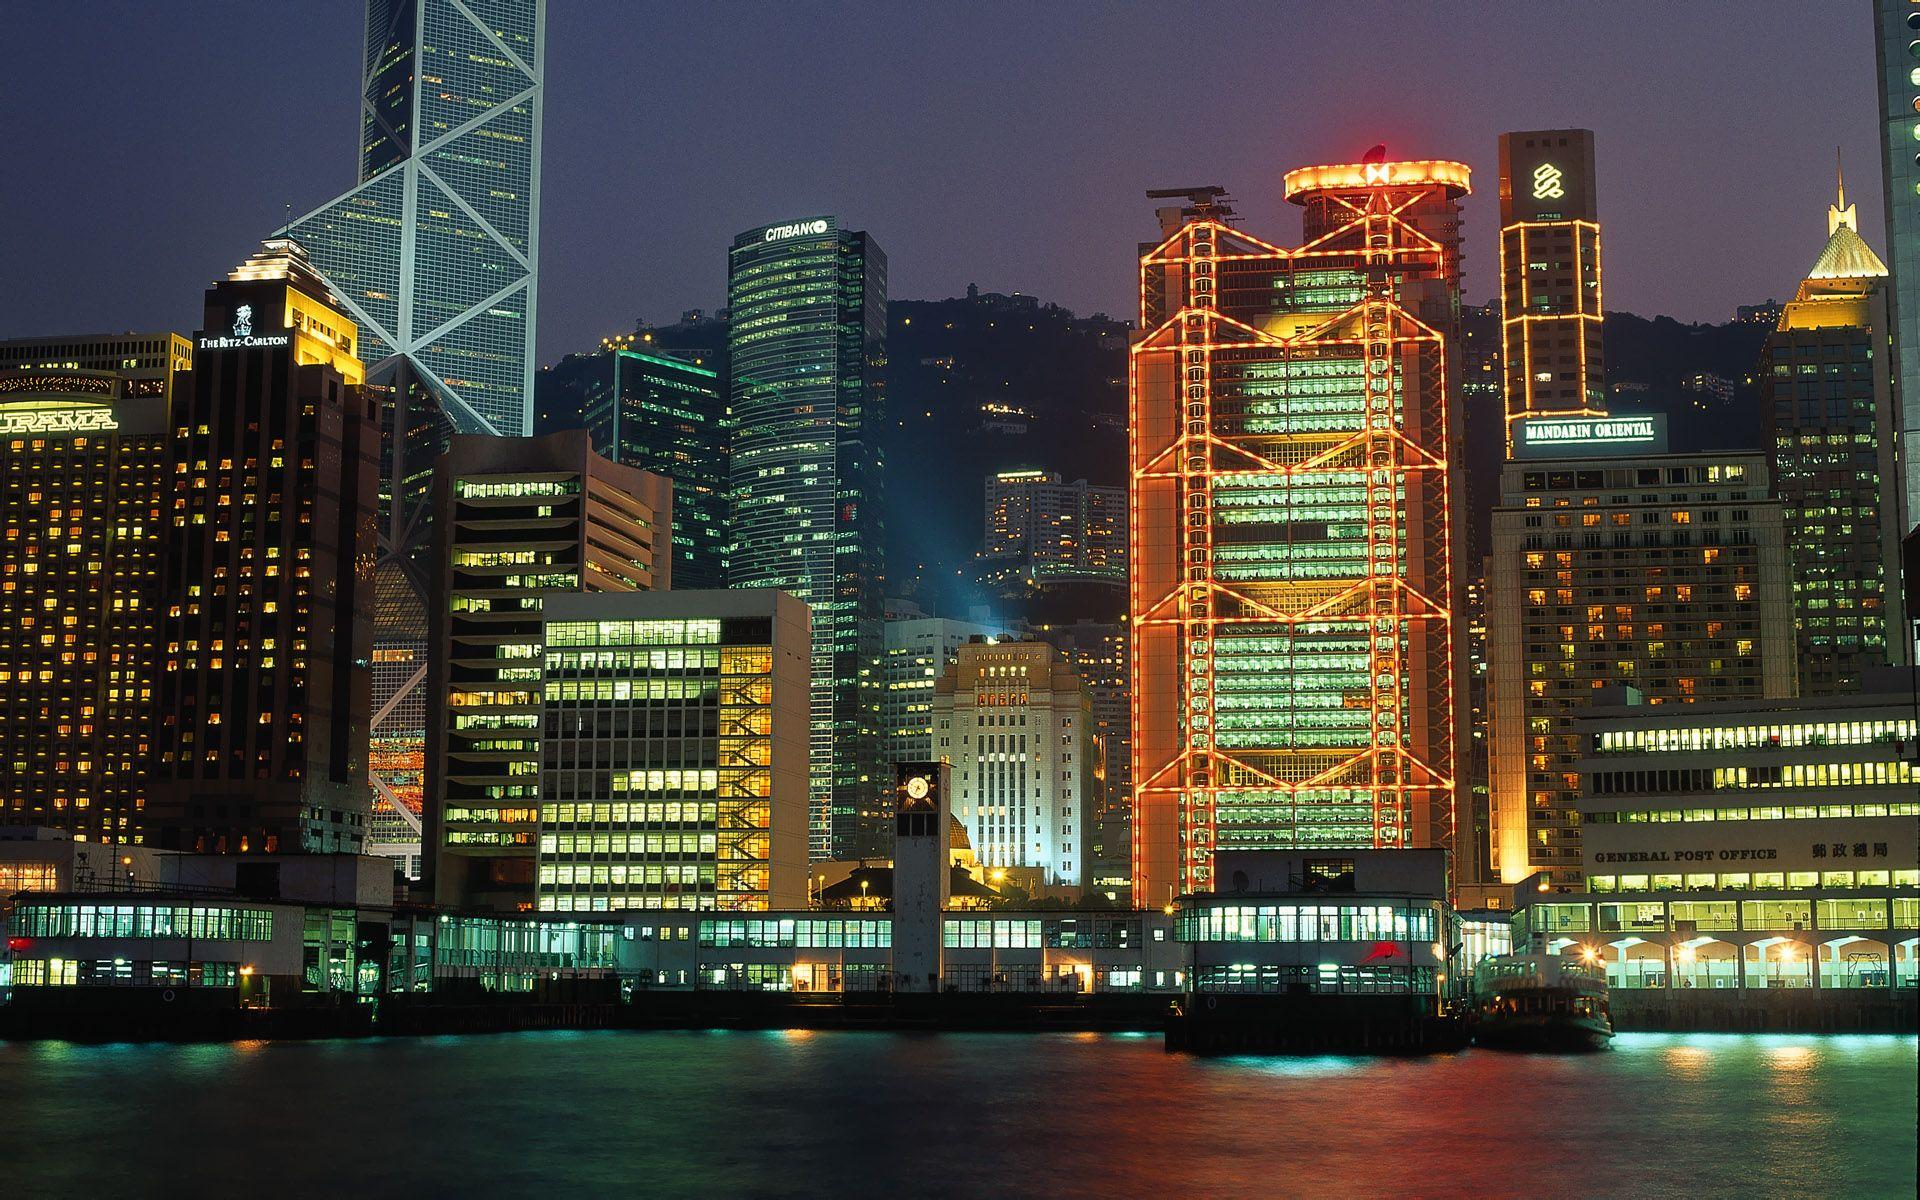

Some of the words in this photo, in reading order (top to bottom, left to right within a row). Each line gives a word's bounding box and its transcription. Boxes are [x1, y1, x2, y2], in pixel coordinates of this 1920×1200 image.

[765, 221, 815, 242] CITIBANK
[1526, 424, 1591, 440] MANDARIN
[1595, 422, 1655, 438] ORIENTAL
[1595, 850, 1670, 863] GENERAL
[1674, 850, 1715, 862] POST
[1719, 848, 1778, 861] OFFICE
[1812, 842, 1888, 859] 郵政總局
